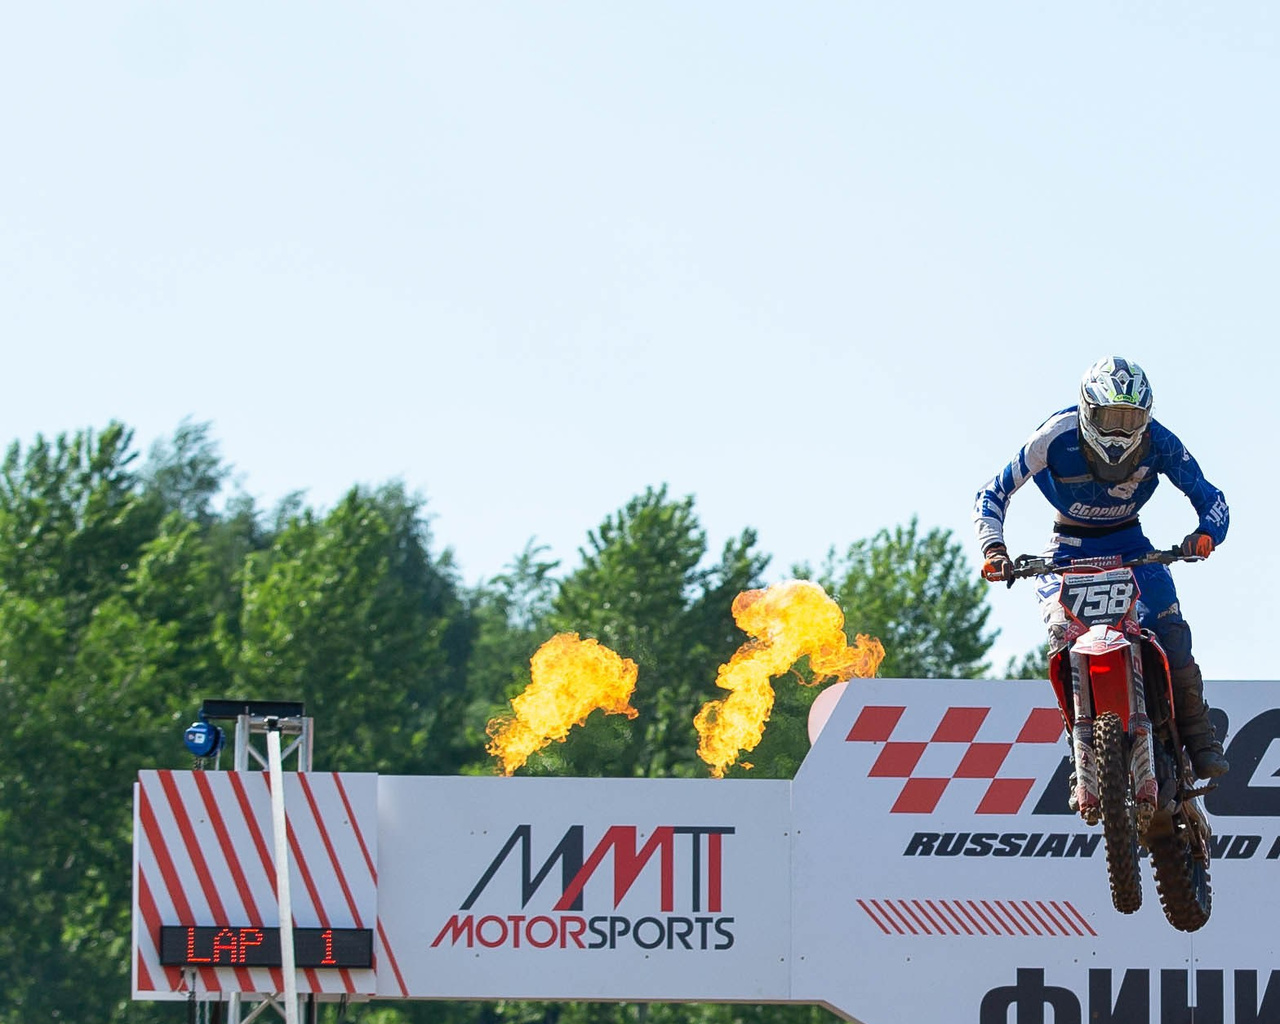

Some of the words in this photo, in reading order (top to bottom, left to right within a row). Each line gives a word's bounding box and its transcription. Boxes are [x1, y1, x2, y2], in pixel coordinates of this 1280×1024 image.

[1068, 582, 1134, 617] 758
[903, 831, 1102, 858] RUSSIAN
[186, 926, 263, 965] LAP
[322, 929, 336, 965] 1
[430, 914, 736, 951] MOTORSPORTS
